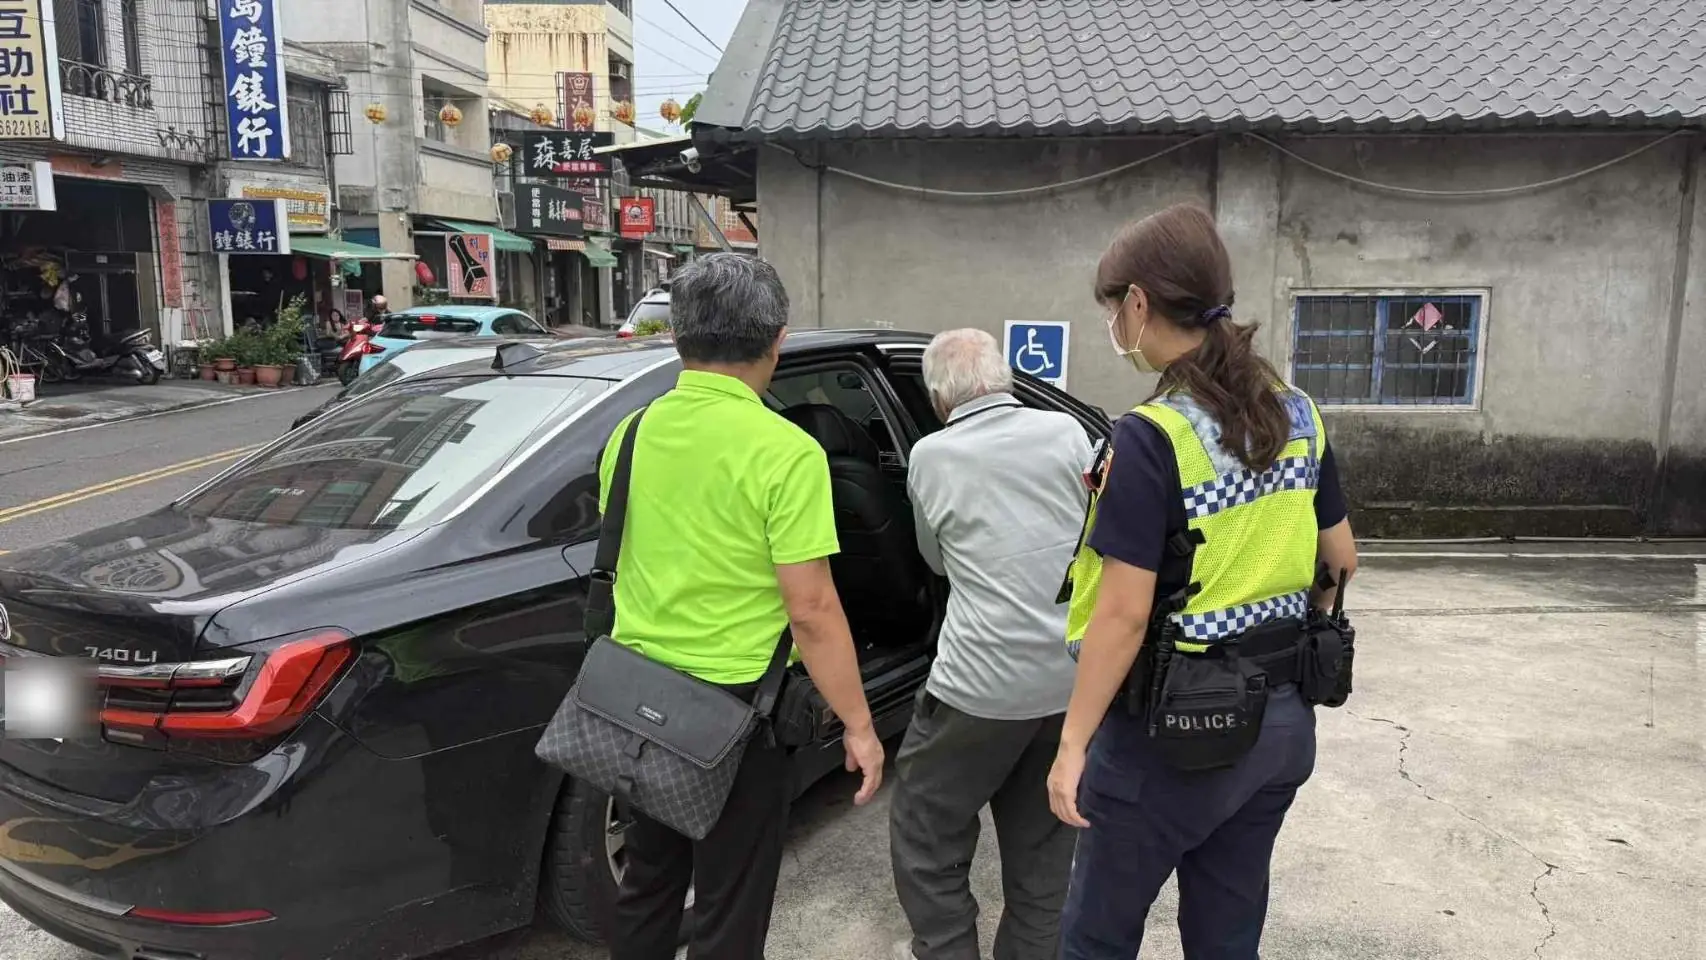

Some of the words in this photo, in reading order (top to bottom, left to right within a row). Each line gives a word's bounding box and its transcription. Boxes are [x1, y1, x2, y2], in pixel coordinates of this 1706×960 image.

[0, 0, 38, 116] 互助社
[229, 0, 276, 157] 島鐘錶行
[532, 136, 594, 170] 森喜屋
[0, 184, 33, 196] 工程
[214, 229, 276, 251] 鐘錶行
[84, 646, 129, 661] 740
[1164, 713, 1237, 730] POLICE
